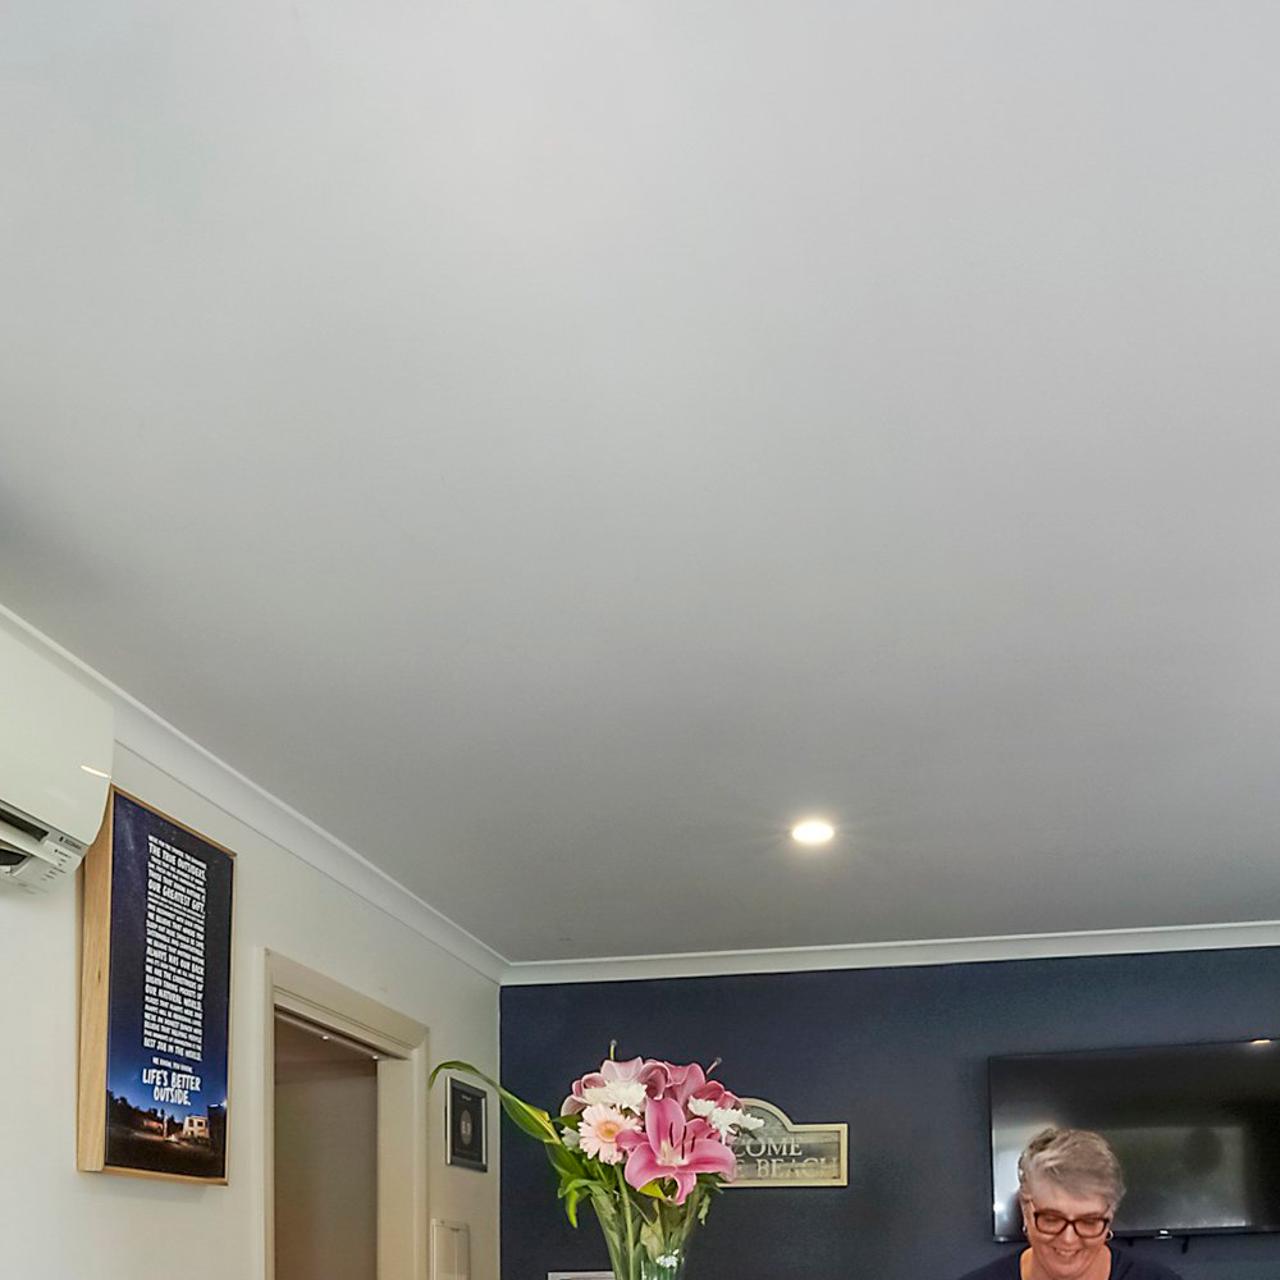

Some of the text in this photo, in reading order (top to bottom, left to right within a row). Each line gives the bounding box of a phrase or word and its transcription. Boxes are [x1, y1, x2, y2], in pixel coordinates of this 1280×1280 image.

[142, 1068, 201, 1092] LIFE'S BETTER
[153, 1086, 191, 1106] OUTSIDE.
